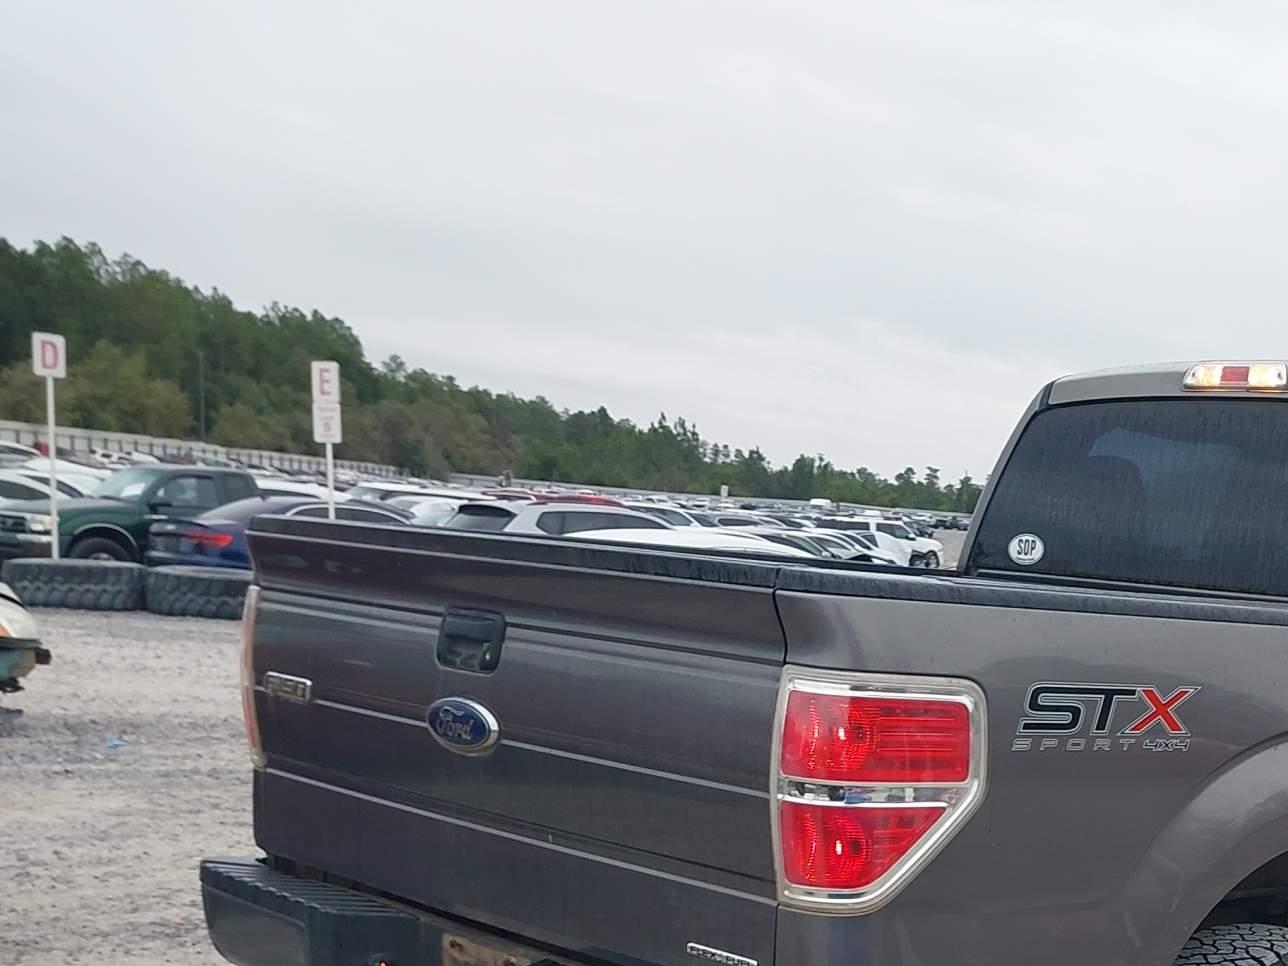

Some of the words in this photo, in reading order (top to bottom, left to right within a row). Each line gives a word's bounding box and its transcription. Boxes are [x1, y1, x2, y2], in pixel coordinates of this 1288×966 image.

[41, 340, 58, 369] D
[319, 368, 332, 396] E
[1017, 539, 1037, 556] SOP
[436, 706, 474, 740] Ford
[1017, 682, 1201, 736] STX
[1012, 738, 1136, 751] SPORT
